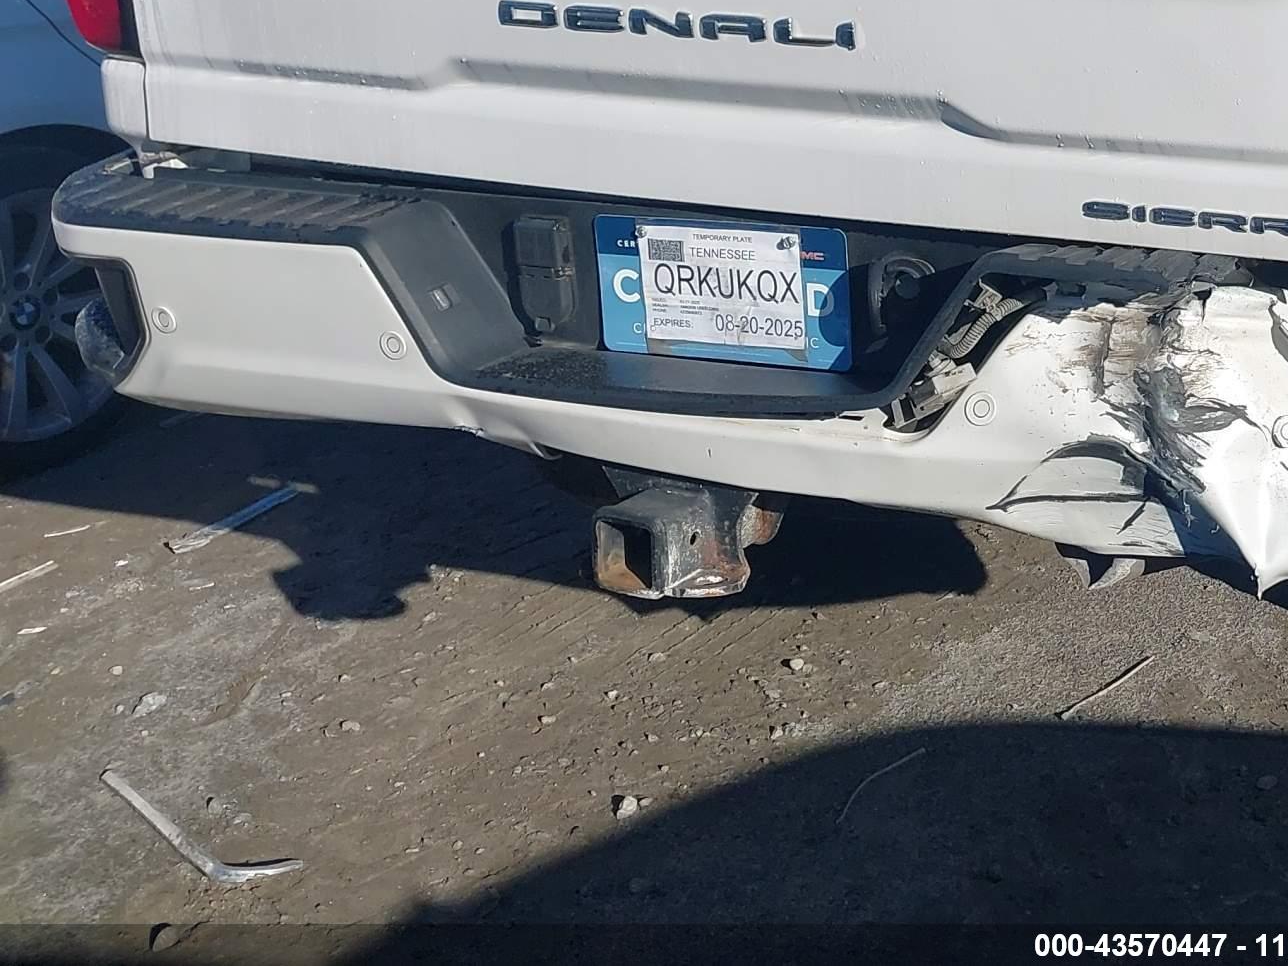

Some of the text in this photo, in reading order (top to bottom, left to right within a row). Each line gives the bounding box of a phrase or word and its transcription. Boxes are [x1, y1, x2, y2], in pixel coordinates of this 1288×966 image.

[498, 0, 856, 50] DENALI
[692, 233, 731, 242] TEMPORARY
[688, 247, 757, 261] TENNESSEE
[800, 250, 825, 261] MC
[653, 263, 801, 304] QRKUKQX
[715, 313, 804, 338] 08-20-2025
